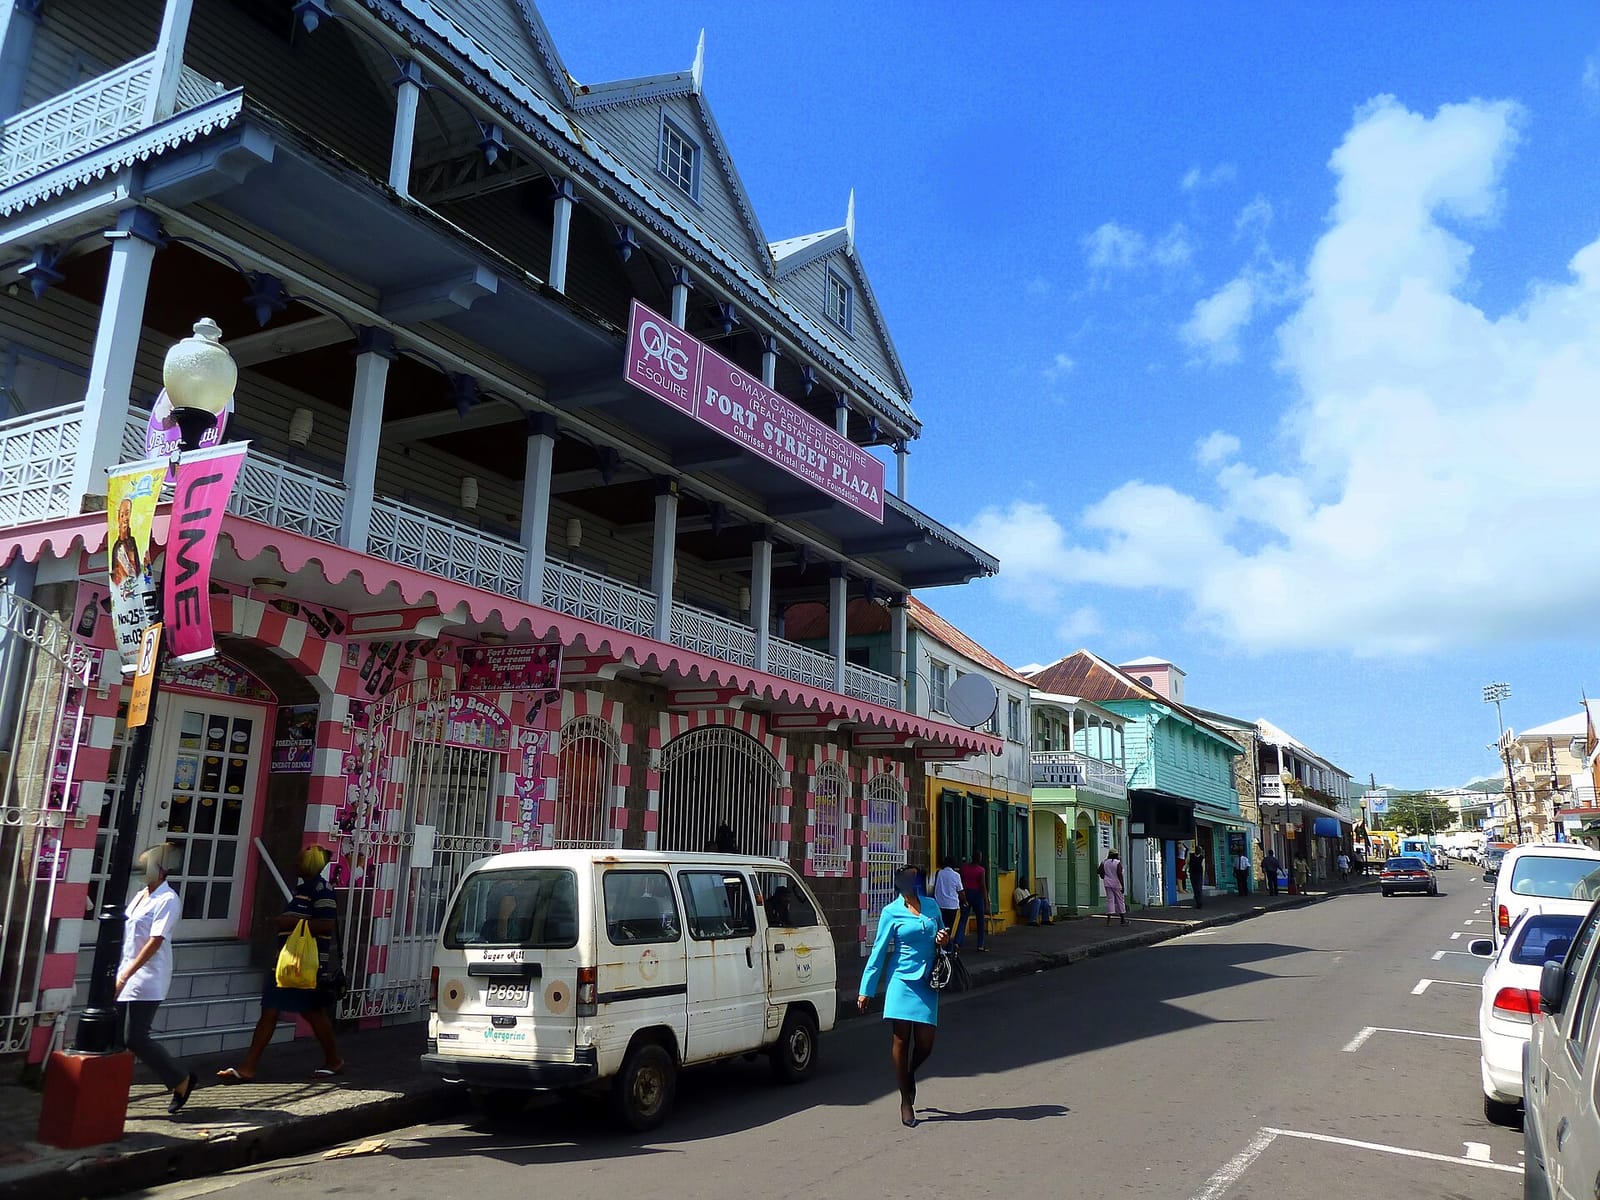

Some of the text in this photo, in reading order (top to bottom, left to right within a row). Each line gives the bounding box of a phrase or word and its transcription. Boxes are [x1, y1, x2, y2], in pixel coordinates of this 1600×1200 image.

[637, 360, 688, 400] ESQUIRE
[705, 385, 879, 504] FORT STREET PLAZA
[730, 372, 866, 468] OMAX GARDNER ESQUIRE
[750, 399, 852, 469] (REAL ESTATE DIVISION)
[733, 425, 859, 504] Cherisse & Kristal Gardner Foundation
[175, 473, 224, 629] LIME
[467, 696, 505, 726] Basics
[276, 739, 298, 748] FOREIGN
[288, 747, 297, 761] &
[488, 984, 529, 1001] P8651
